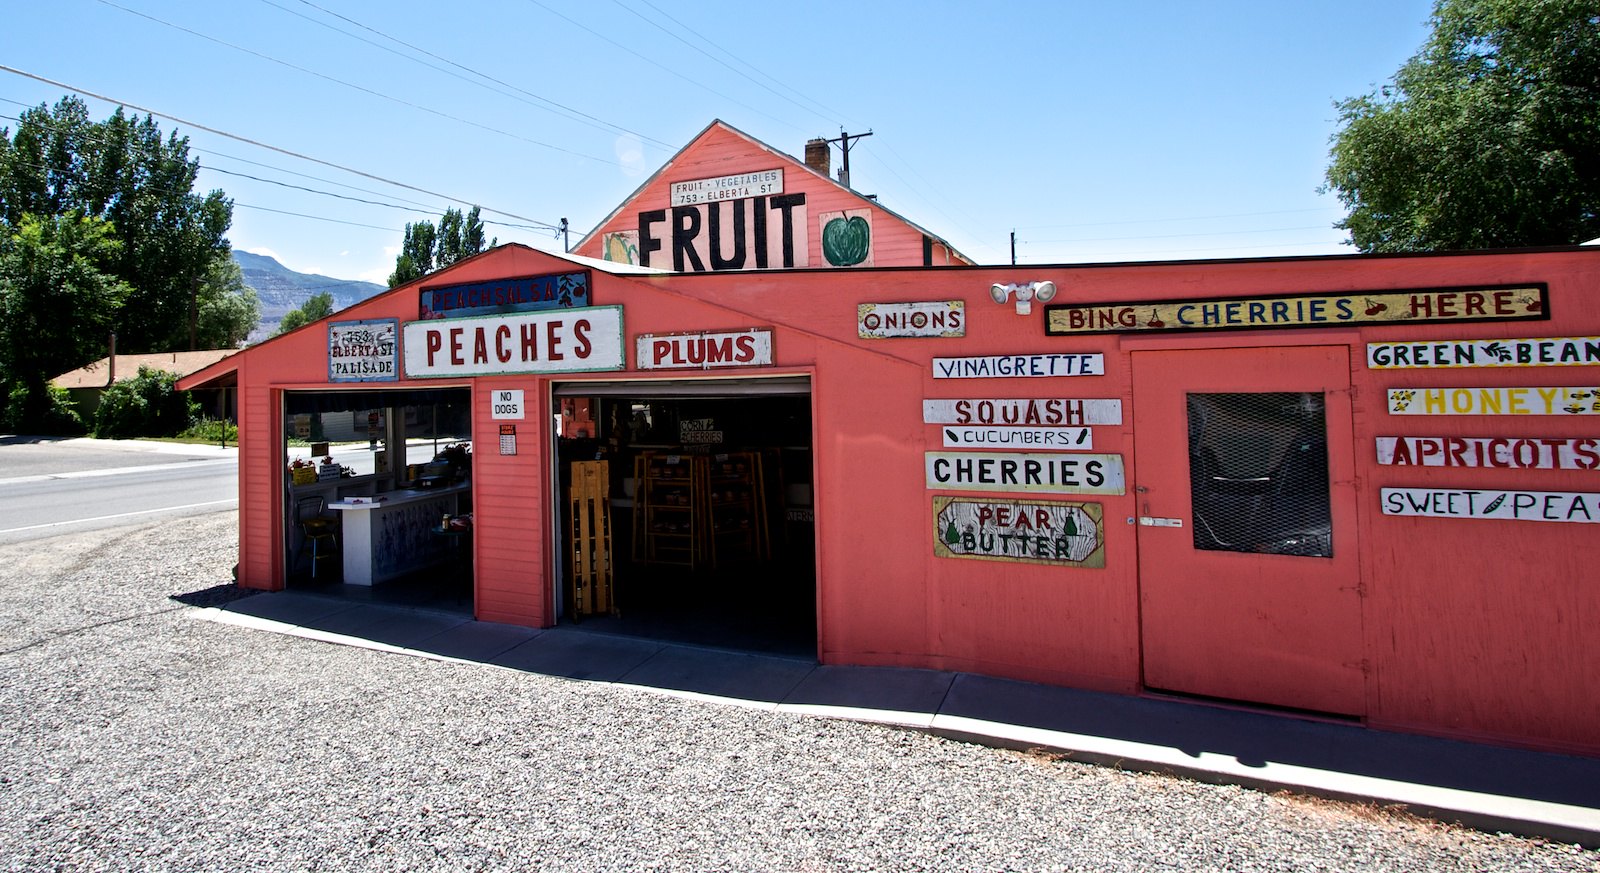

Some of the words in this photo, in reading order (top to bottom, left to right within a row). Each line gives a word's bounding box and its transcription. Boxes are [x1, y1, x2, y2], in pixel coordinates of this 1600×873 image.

[676, 182, 703, 193] FRUIT
[715, 171, 777, 188] VEGETABLES
[680, 194, 698, 203] 753
[707, 188, 749, 200] ELBERTA
[760, 184, 773, 194] ST
[639, 193, 805, 271] FRUIT
[863, 311, 961, 330] ONIONS
[1069, 308, 1136, 329] BING
[1177, 299, 1353, 327] CHERRIES
[1410, 291, 1516, 318] HERE
[346, 330, 370, 344] 753
[426, 319, 592, 367] PEACHES
[332, 345, 379, 358] ELBERTA
[380, 343, 393, 355] ST
[653, 335, 756, 365] PLUMS
[1372, 344, 1476, 366] GREEN
[336, 361, 393, 374] PALISADE
[939, 355, 1093, 378] VINAIGRETTE
[500, 392, 512, 402] NO
[495, 404, 518, 414] DOGS
[955, 400, 1084, 425] SQUASH
[681, 420, 704, 431] CORN
[963, 430, 1070, 445] CUCUMBERS
[1391, 438, 1600, 468] APRICOTS
[933, 458, 1105, 487] CHERRIES
[1387, 492, 1480, 515] SWEET
[1513, 493, 1600, 520] PEA
[979, 507, 1051, 530] PEAR
[963, 532, 1070, 557] BUTTER
